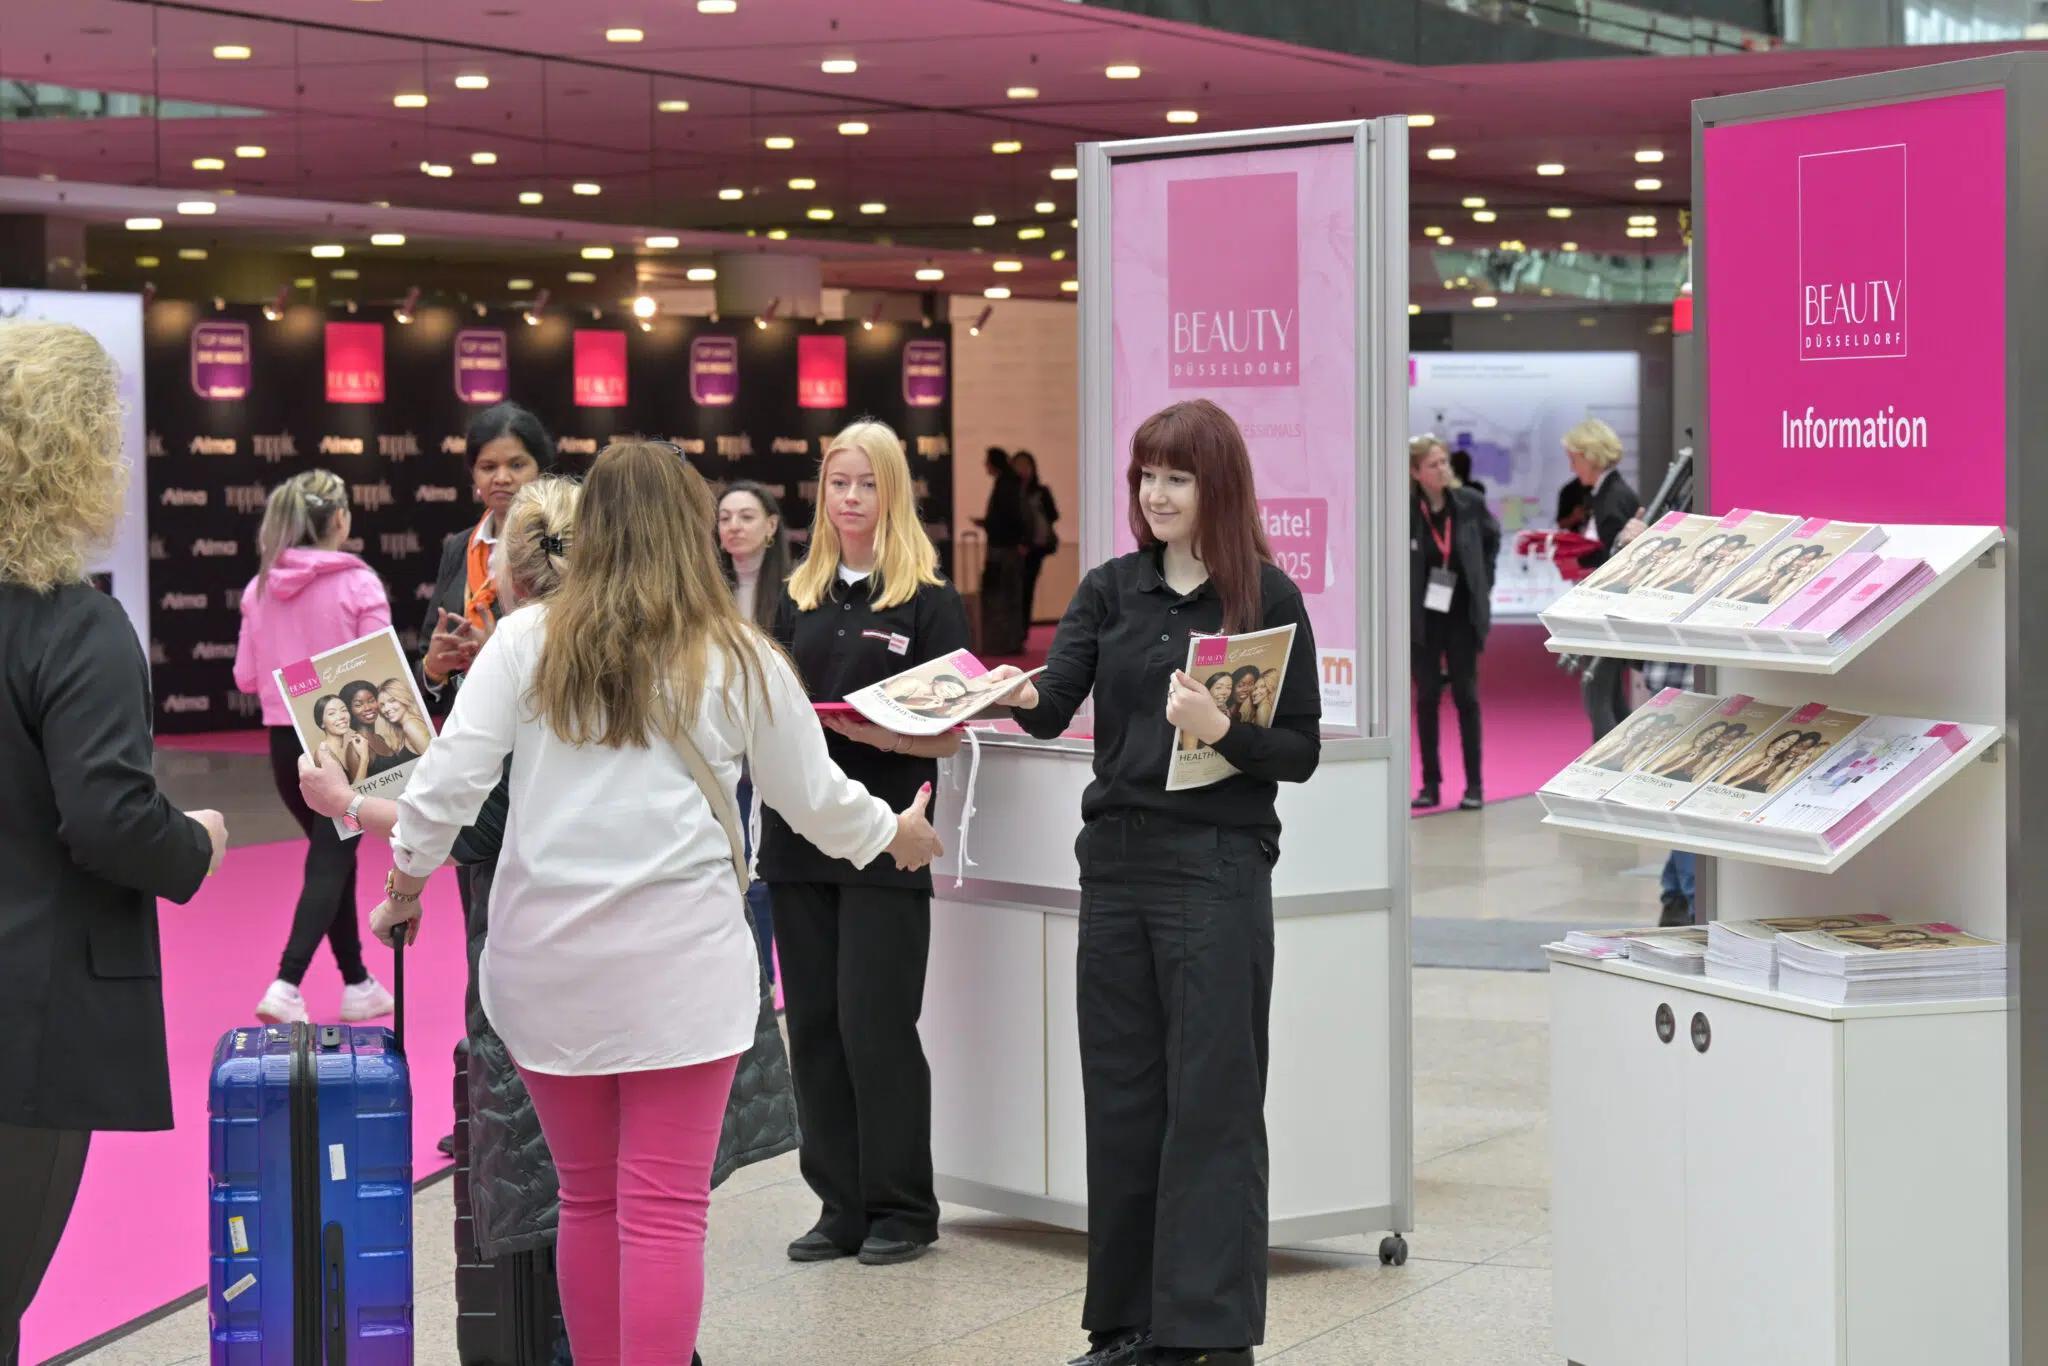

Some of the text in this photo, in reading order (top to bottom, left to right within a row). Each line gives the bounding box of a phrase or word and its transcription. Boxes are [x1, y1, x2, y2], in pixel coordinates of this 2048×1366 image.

[1805, 279, 1902, 326] BEAUTY
[1174, 308, 1293, 353] BEAUTY
[1805, 332, 1901, 349] DÜSSELDORF
[1174, 361, 1292, 377] DÜSSELDORF
[1783, 405, 1927, 448] Information
[379, 769, 403, 787] SKIN
